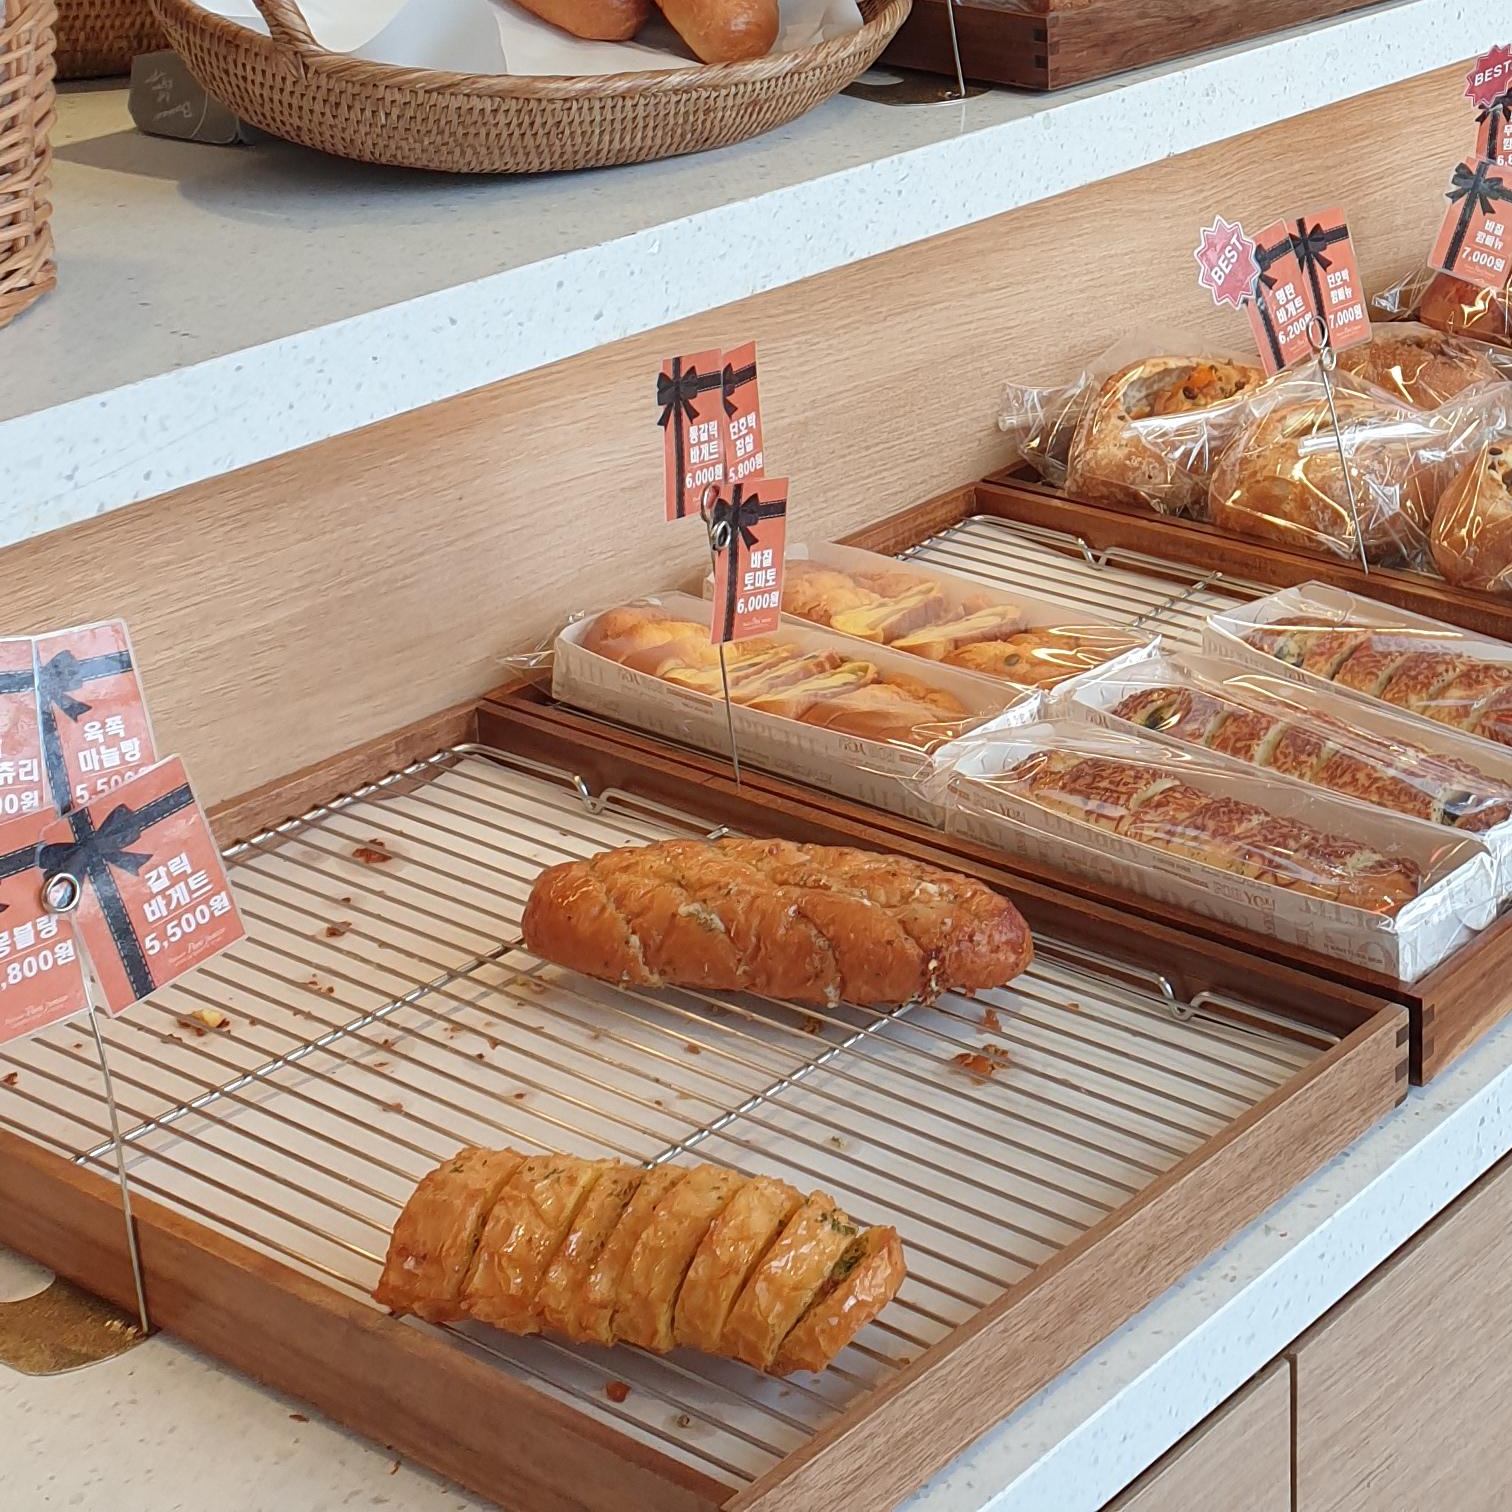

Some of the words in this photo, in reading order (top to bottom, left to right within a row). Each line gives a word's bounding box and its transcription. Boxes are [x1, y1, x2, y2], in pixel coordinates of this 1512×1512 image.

[1474, 59, 1512, 87] BEST
[1210, 234, 1245, 286] BEST
[1462, 247, 1506, 273] 7,000원
[1276, 299, 1306, 325] 바게트
[1329, 304, 1363, 329] 7,000원
[689, 420, 718, 444] 통갈릭
[729, 412, 756, 440] 단호박
[690, 441, 719, 463] 바게트
[686, 463, 723, 488] 6,000원
[728, 452, 763, 483] 5,800원
[750, 548, 773, 569] 바질
[744, 568, 777, 591] 토마토
[736, 591, 780, 615] 6,000원
[78, 737, 141, 773] 마늘빵
[145, 853, 192, 895] 갈릭
[142, 870, 213, 925] 바게트
[145, 891, 233, 956] 5,500원
